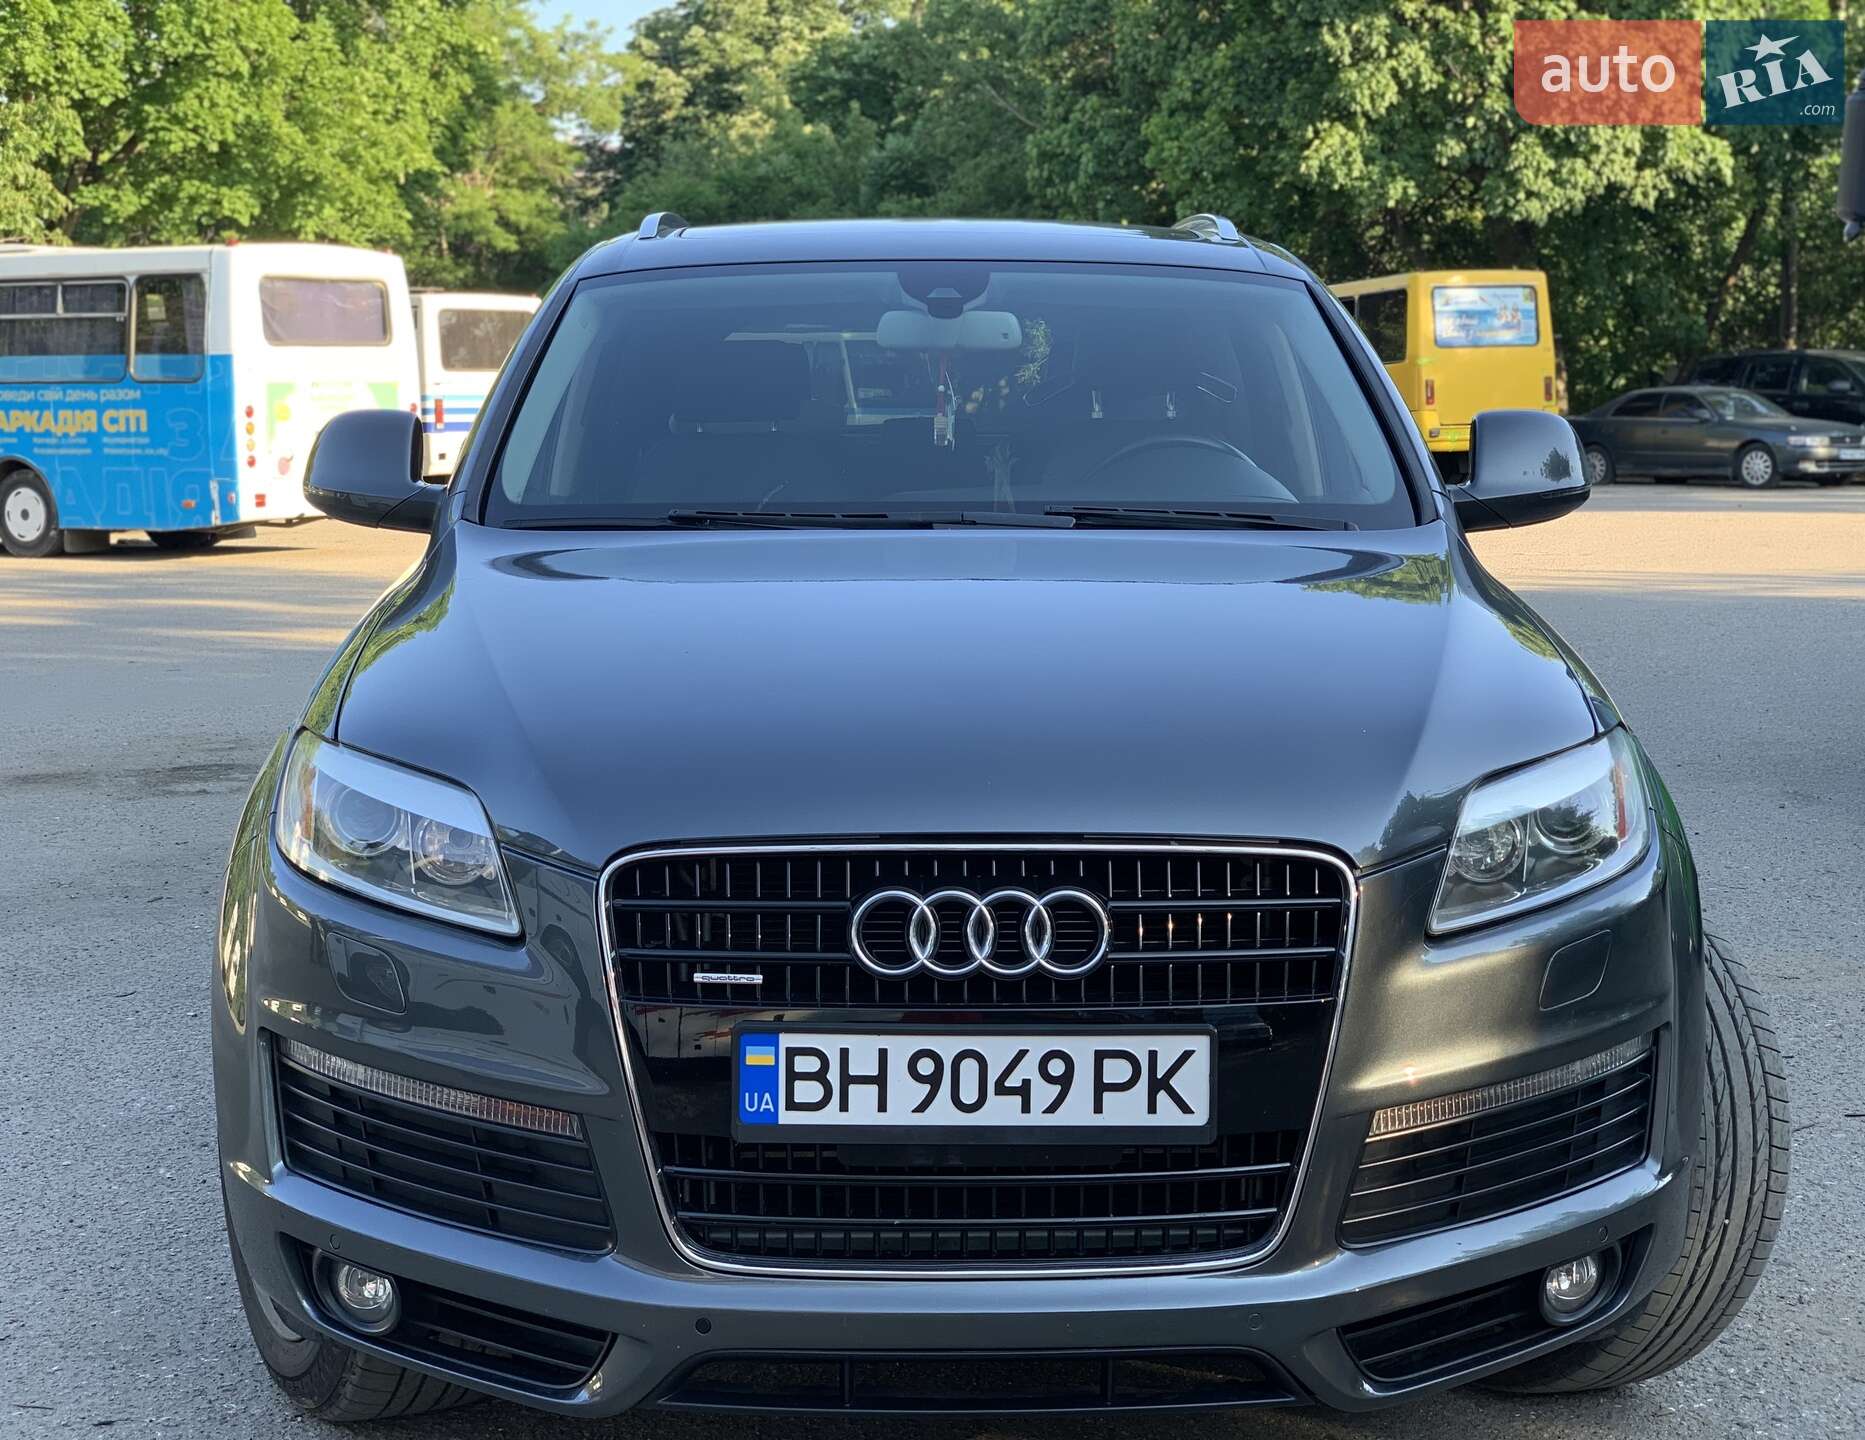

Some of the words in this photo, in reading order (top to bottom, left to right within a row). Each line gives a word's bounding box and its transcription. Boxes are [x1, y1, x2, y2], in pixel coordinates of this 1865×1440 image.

[701, 974, 756, 982] quattro
[784, 1046, 889, 1113] BH
[907, 1047, 1075, 1115] 9049
[1093, 1048, 1197, 1115] PK
[745, 1092, 775, 1113] UA
